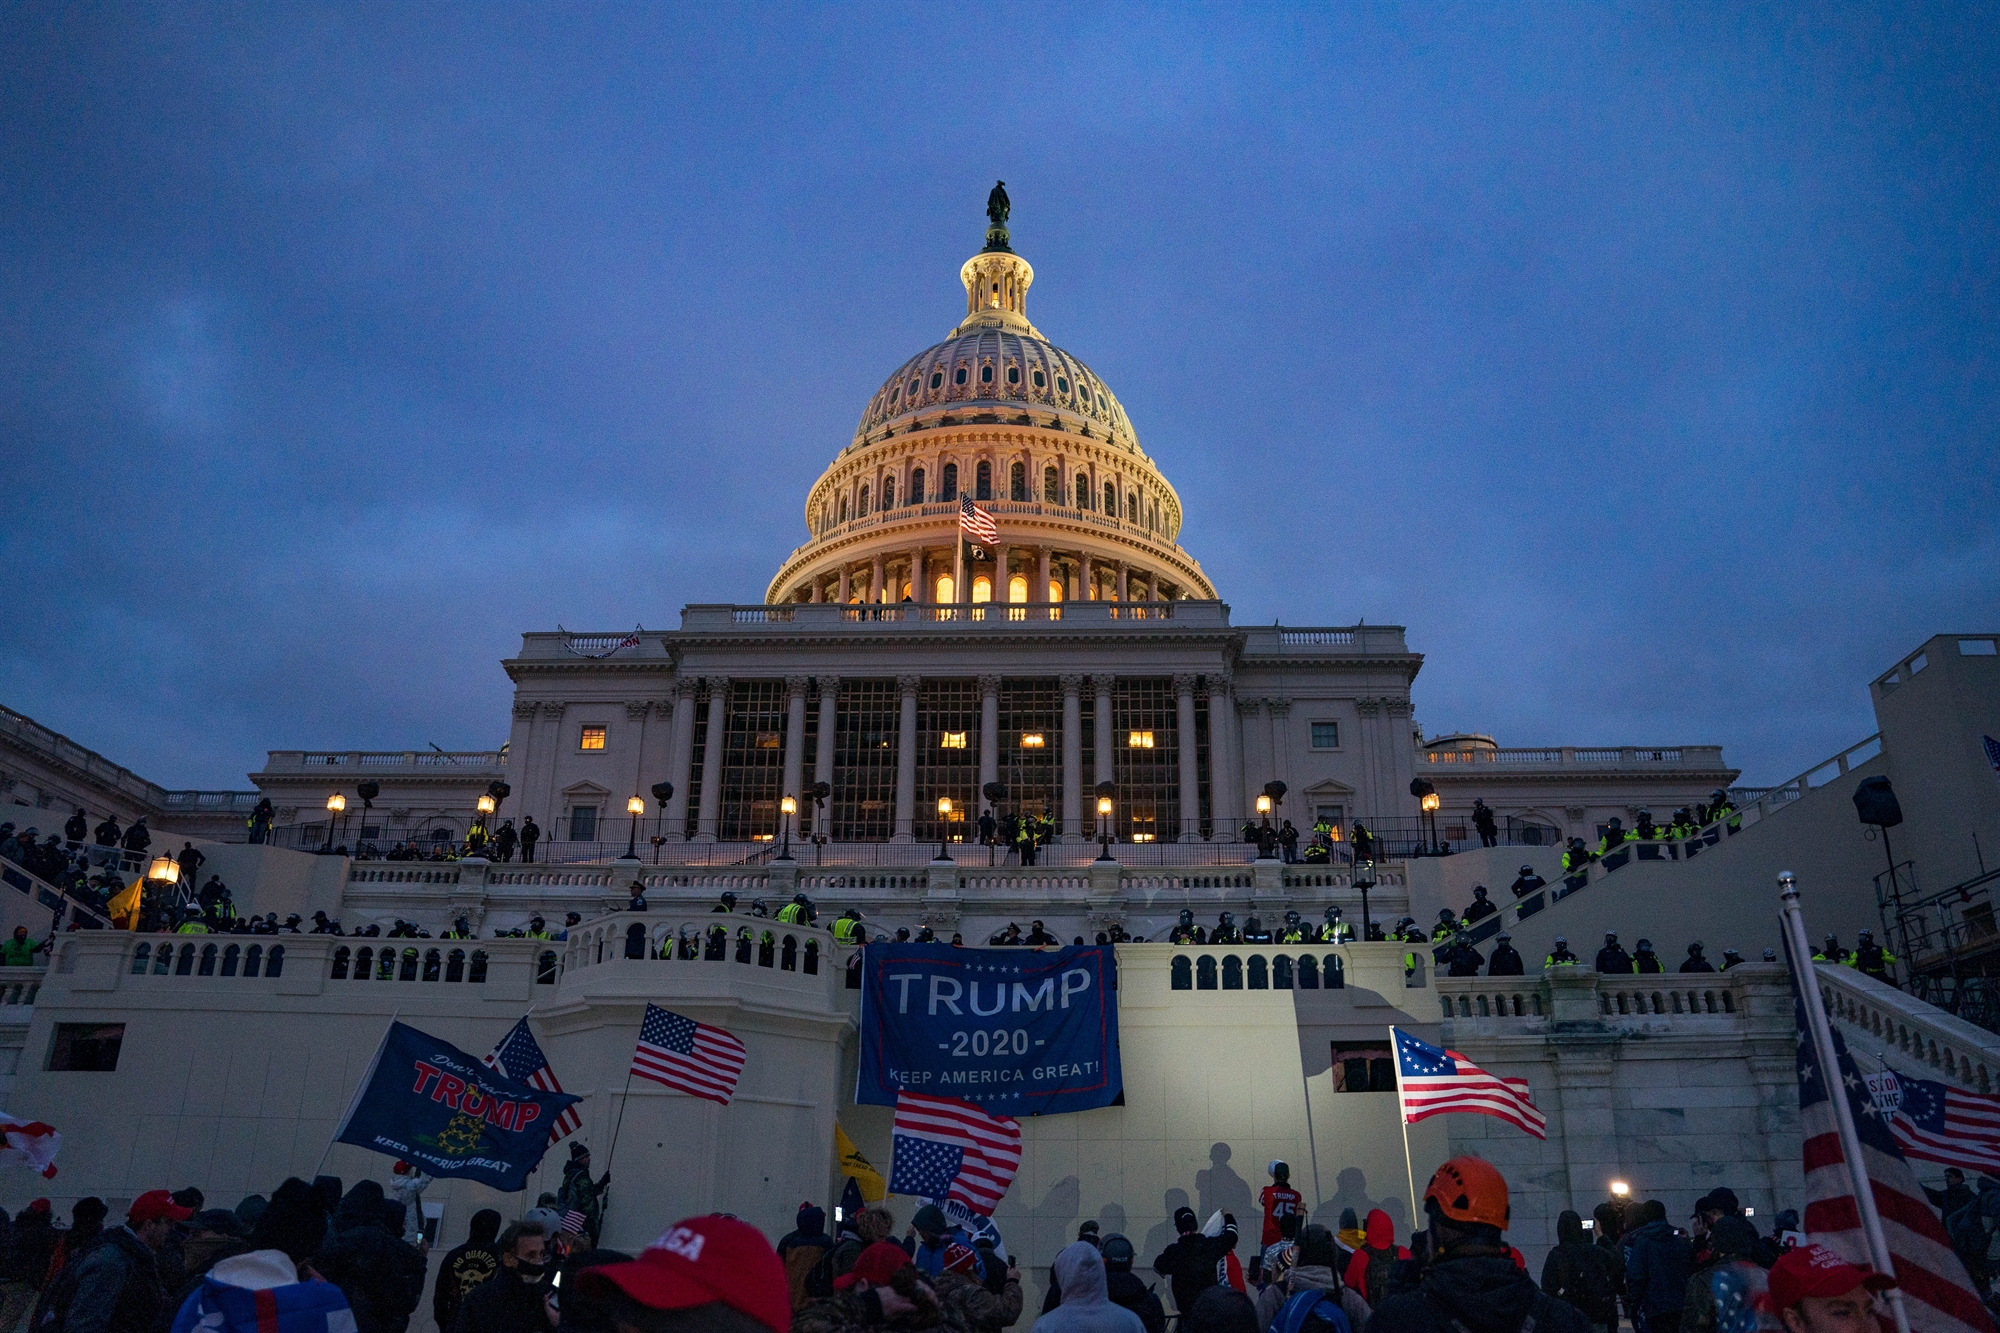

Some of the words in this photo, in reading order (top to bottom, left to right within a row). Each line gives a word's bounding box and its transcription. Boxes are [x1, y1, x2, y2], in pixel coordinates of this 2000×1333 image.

[889, 968, 1091, 1016] TRUMP
[430, 1054, 475, 1076] Don't
[889, 1068, 932, 1084] KEEP
[939, 1069, 1024, 1084] AMERICA
[1032, 1060, 1099, 1080] GREAT!
[412, 1060, 541, 1132] TRUMP
[466, 1157, 512, 1173] GREAT
[1272, 1192, 1296, 1200] TRUMP
[1272, 1201, 1296, 1221] 45
[453, 1257, 464, 1269] NO
[465, 1250, 496, 1269] QUARTER
